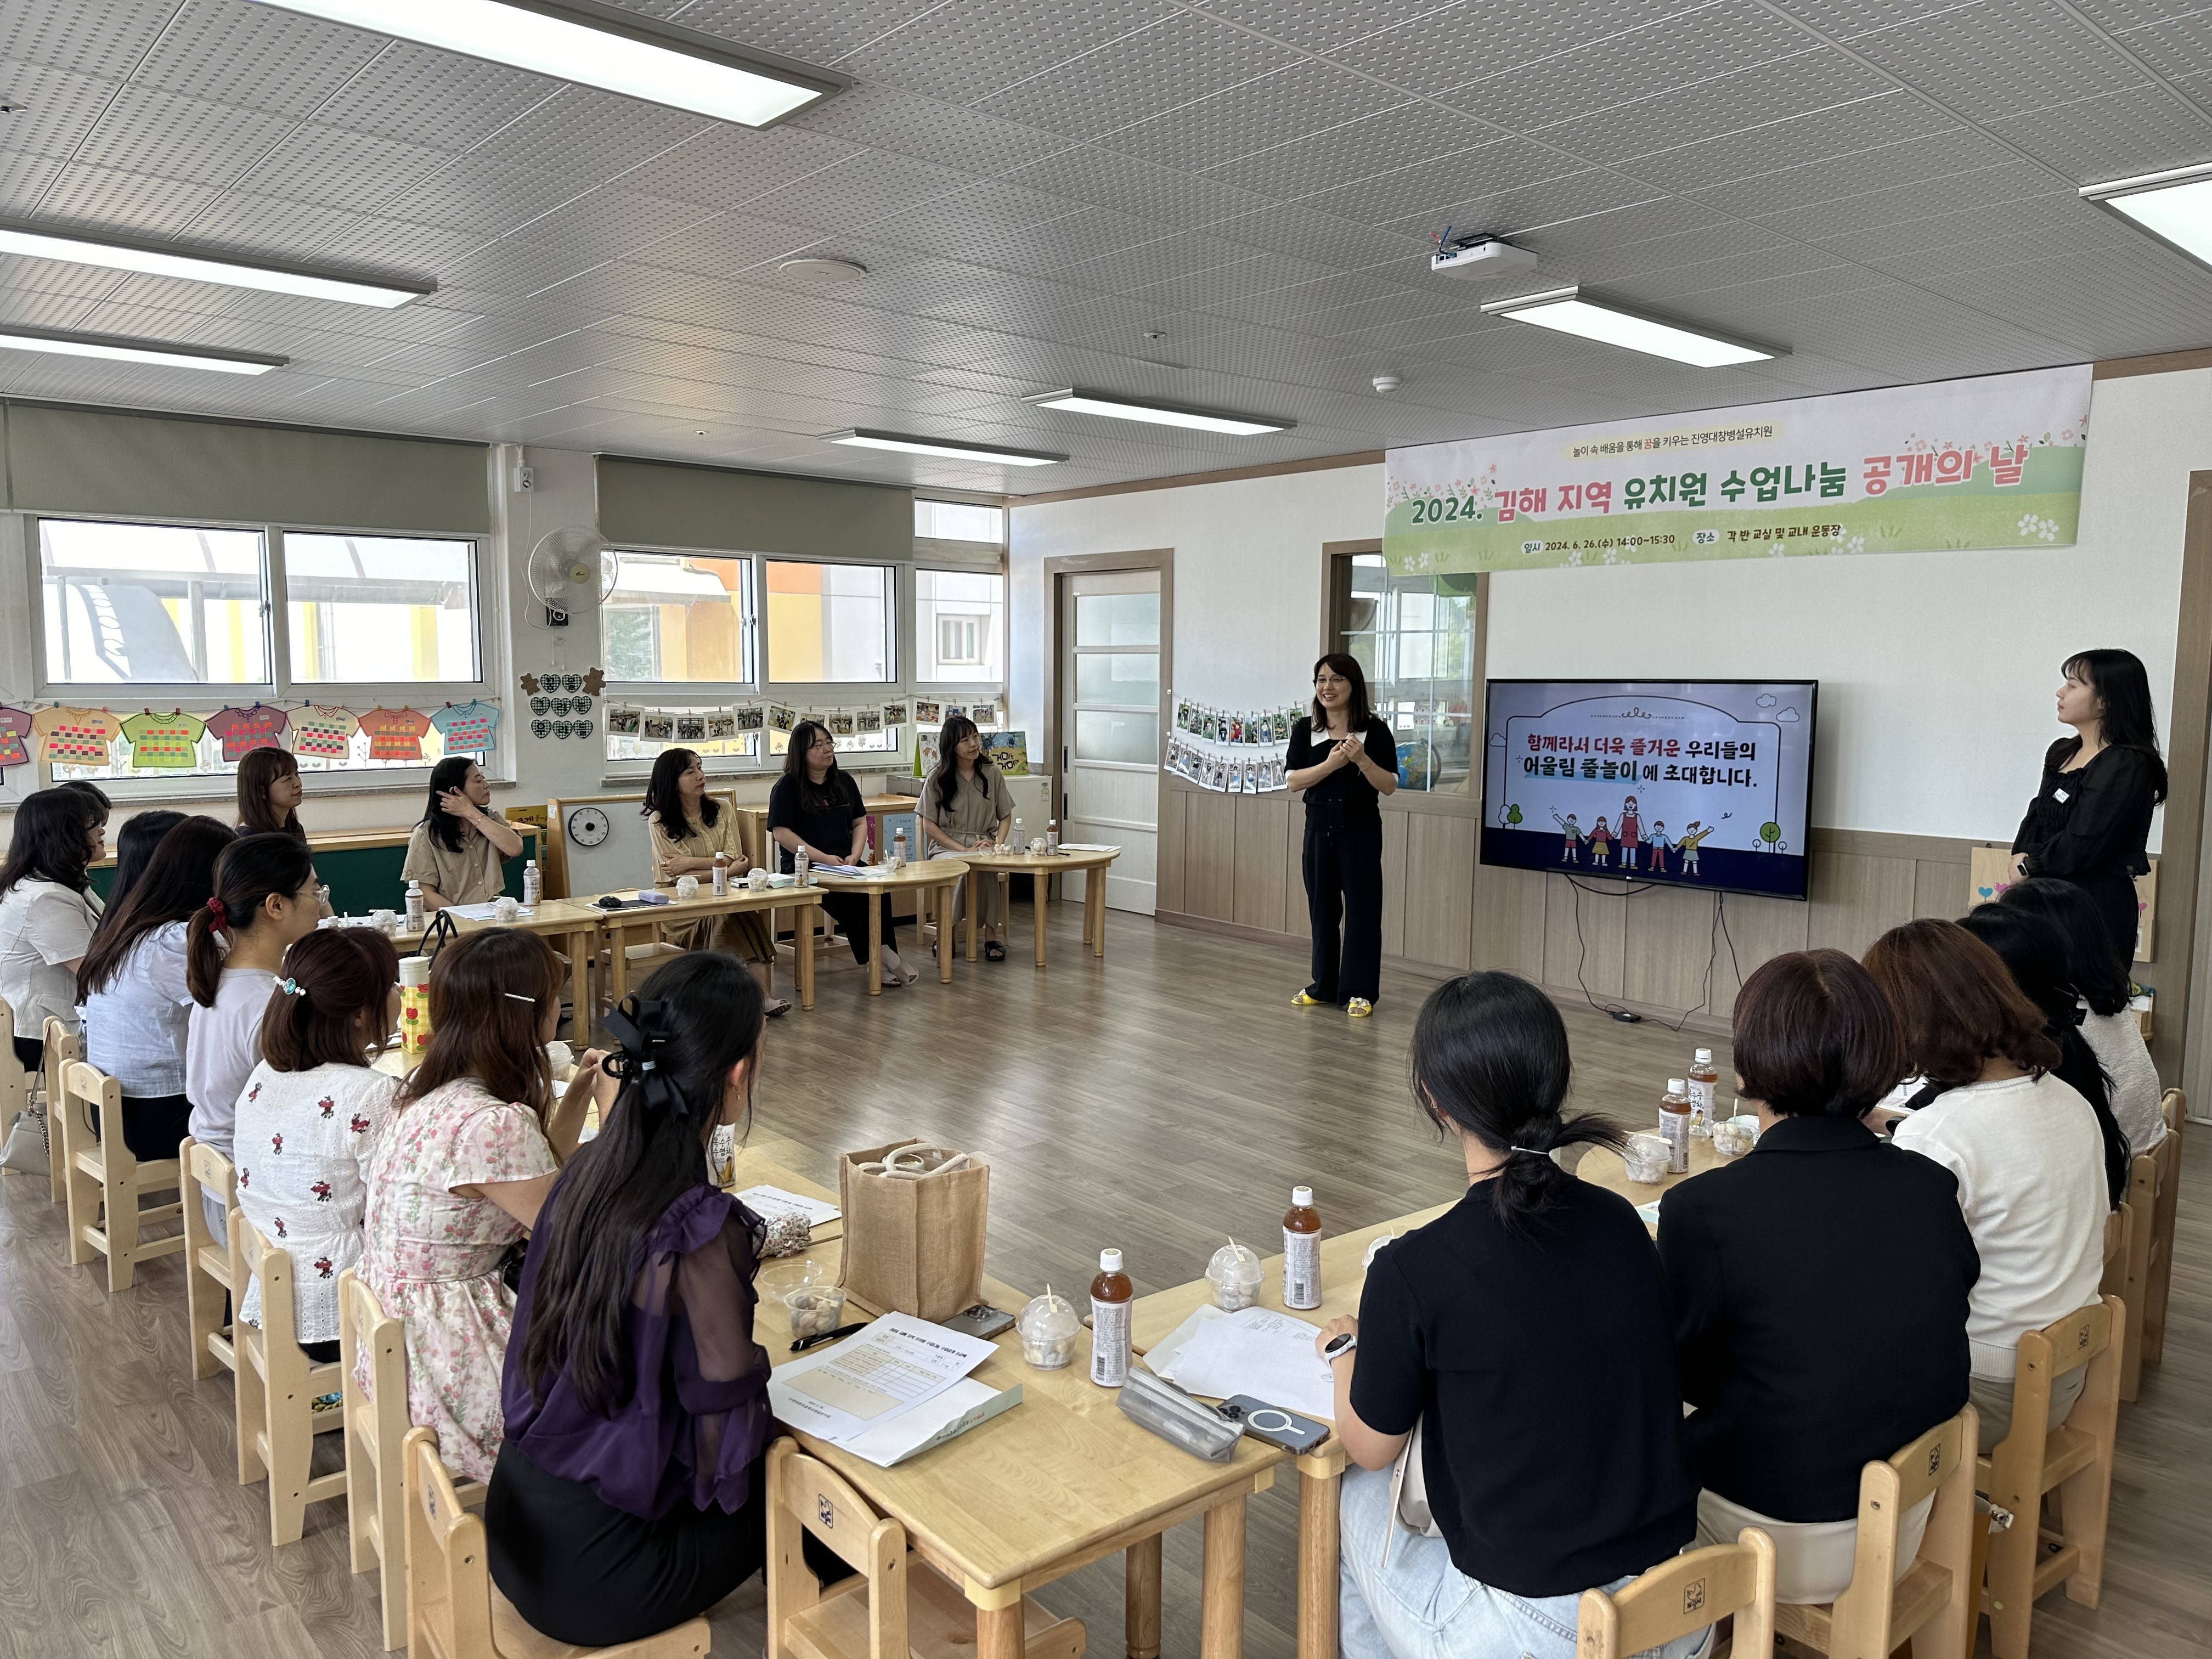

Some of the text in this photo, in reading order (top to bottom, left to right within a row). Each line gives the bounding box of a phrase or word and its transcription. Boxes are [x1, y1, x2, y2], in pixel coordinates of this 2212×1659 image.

[1573, 425, 1772, 457] 놀이 속 배움을 통해 꿈을 키우는 진영대창병설유치원
[1412, 443, 2030, 524] 2024. 김해 지역 유치원 수업나눔 공개의 날
[1524, 534, 1675, 552] 일시 2024. 6. 26.(수) 14:00~15:30
[1696, 524, 1841, 544] 장소 각 반 교실 및 교내 운동장
[533, 699, 586, 712] 그리는
[535, 723, 587, 736] 우리들
[1527, 733, 1756, 760] 함께라서 더욱 즐거운 우리들의
[1524, 755, 1757, 787] 어울림 줄놀이 에 초대합니다.
[713, 1136, 731, 1148] 옥수수
